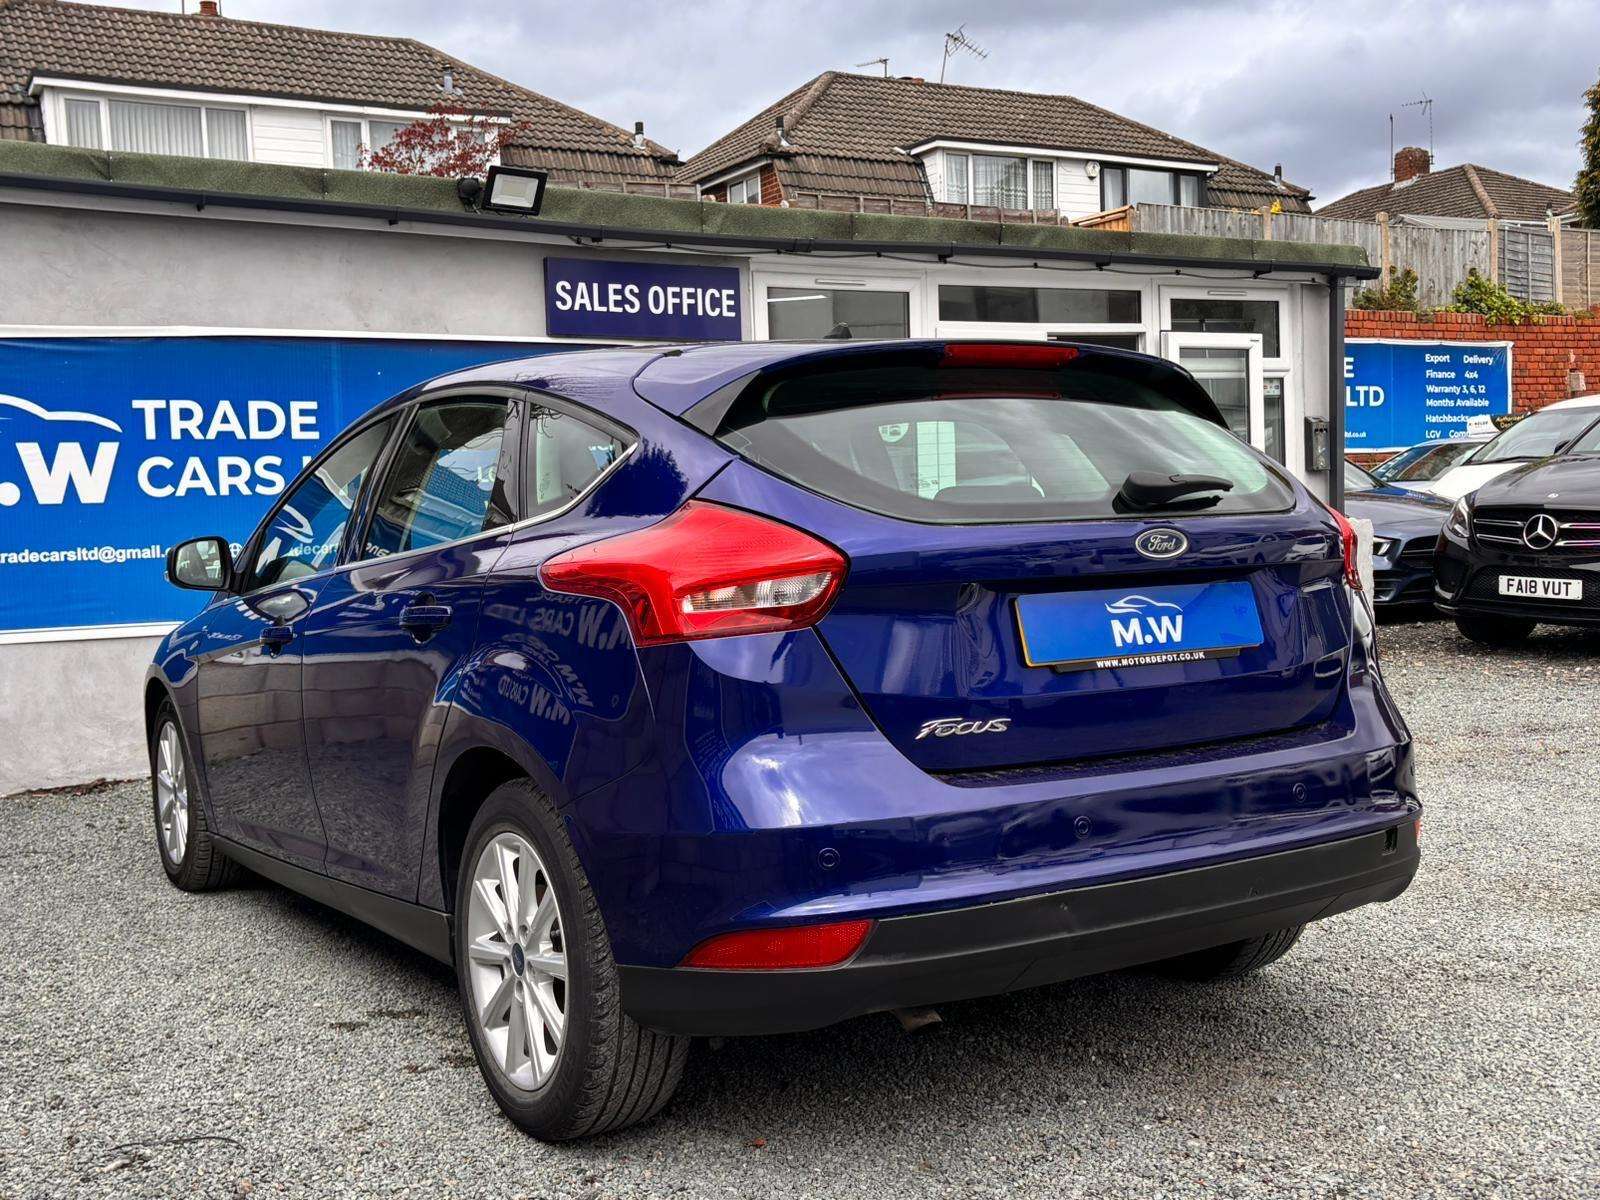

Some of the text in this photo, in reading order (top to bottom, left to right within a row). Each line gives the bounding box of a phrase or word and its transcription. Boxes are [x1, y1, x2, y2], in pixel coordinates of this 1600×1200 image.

[555, 280, 736, 318] SALES OFFICE
[1425, 354, 1493, 366] Export Delivery
[1426, 370, 1479, 379] Finance 4x4
[1345, 386, 1385, 407] LTD
[1425, 385, 1461, 395] Warranty
[1477, 385, 1486, 394] 12
[1426, 398, 1490, 407] Months Available
[131, 399, 320, 440] TRADE
[1425, 430, 1441, 439] LGV
[137, 454, 286, 498] CARS
[1148, 534, 1176, 551] Ford
[1506, 578, 1572, 597] FA18 VUT
[1110, 614, 1183, 648] M.W
[1096, 651, 1207, 669] WWW.MOTORDEPOT.CO.UK
